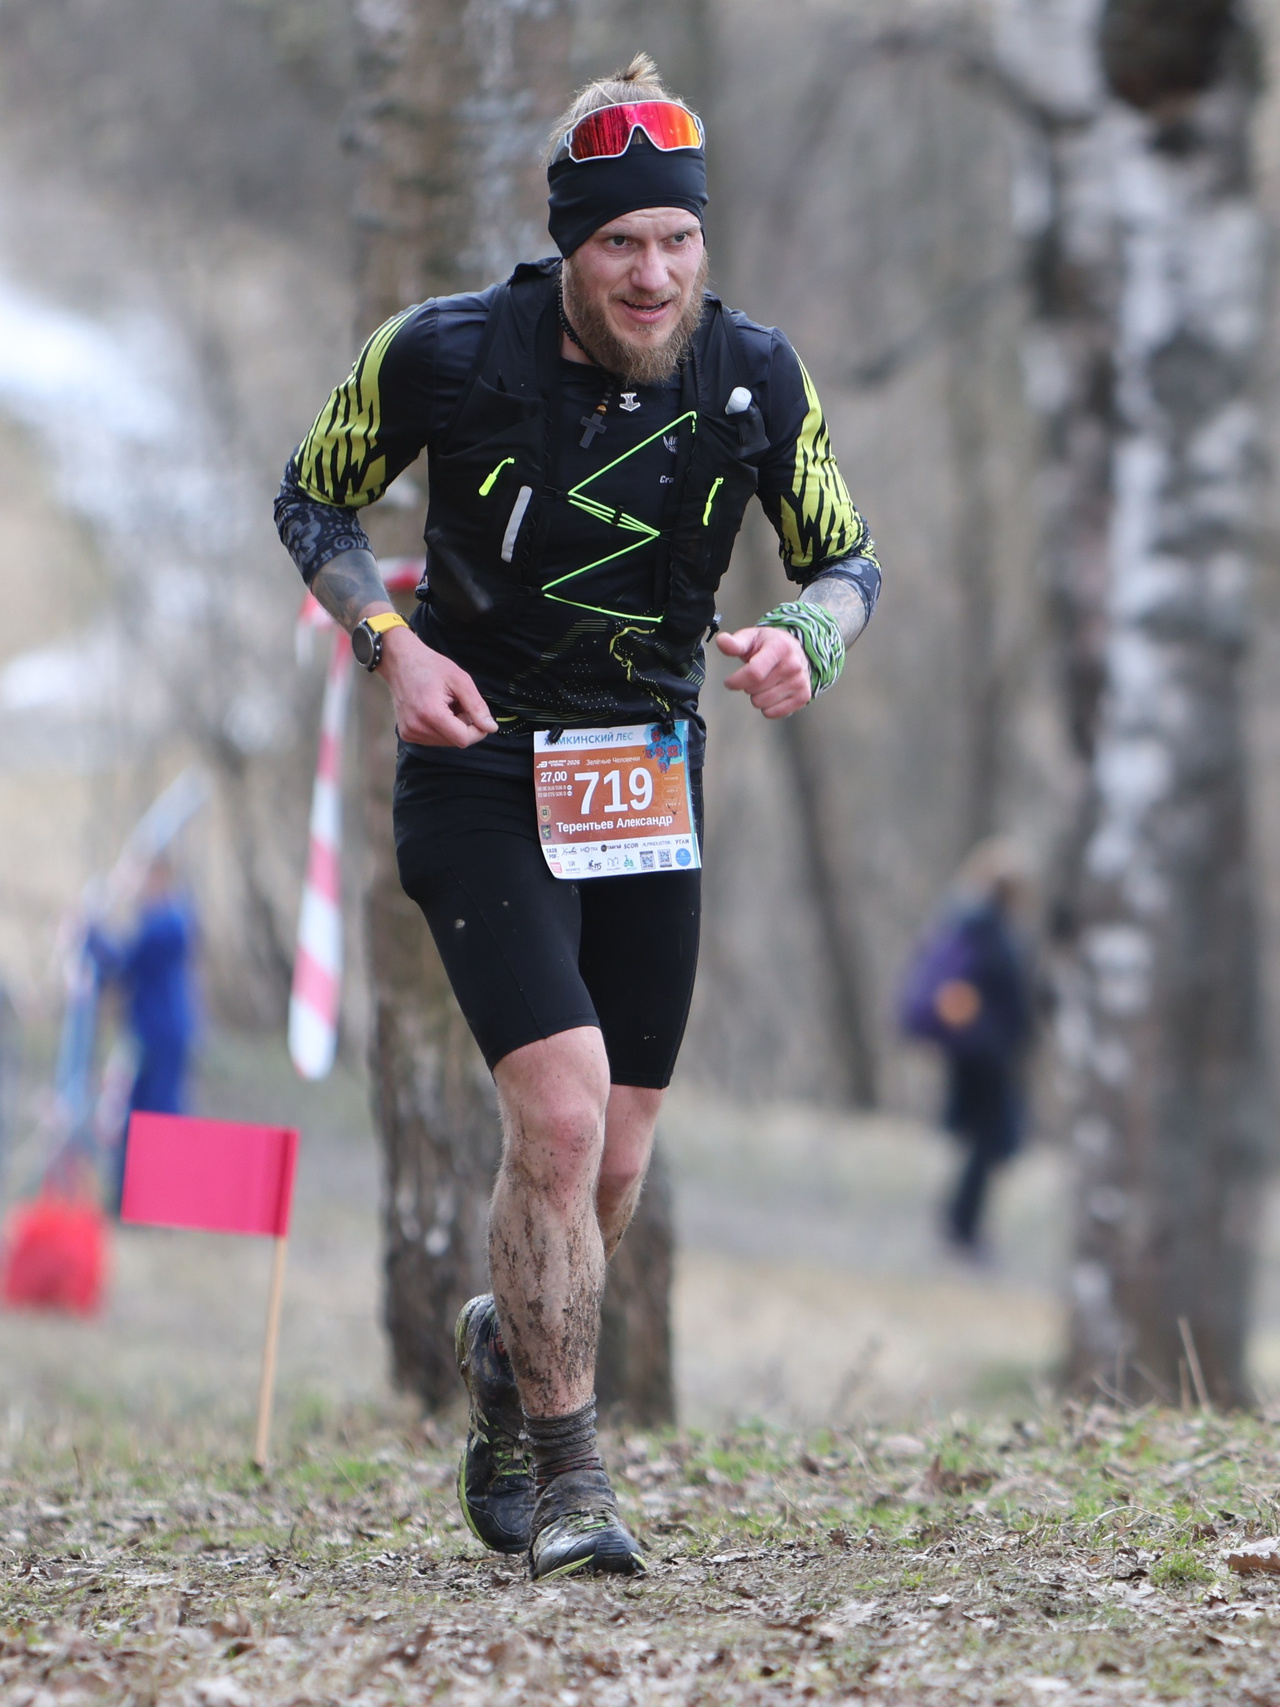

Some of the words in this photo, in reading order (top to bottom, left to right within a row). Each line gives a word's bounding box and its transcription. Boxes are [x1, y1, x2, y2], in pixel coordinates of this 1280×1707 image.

[544, 732, 614, 747] ХМКИНСКИЙ
[616, 732, 634, 742] ЛЕС
[612, 756, 641, 765] Человечки
[540, 771, 568, 784] 27,00
[574, 767, 653, 815] 719
[556, 819, 615, 835] Терентьев
[616, 814, 674, 830] Александр
